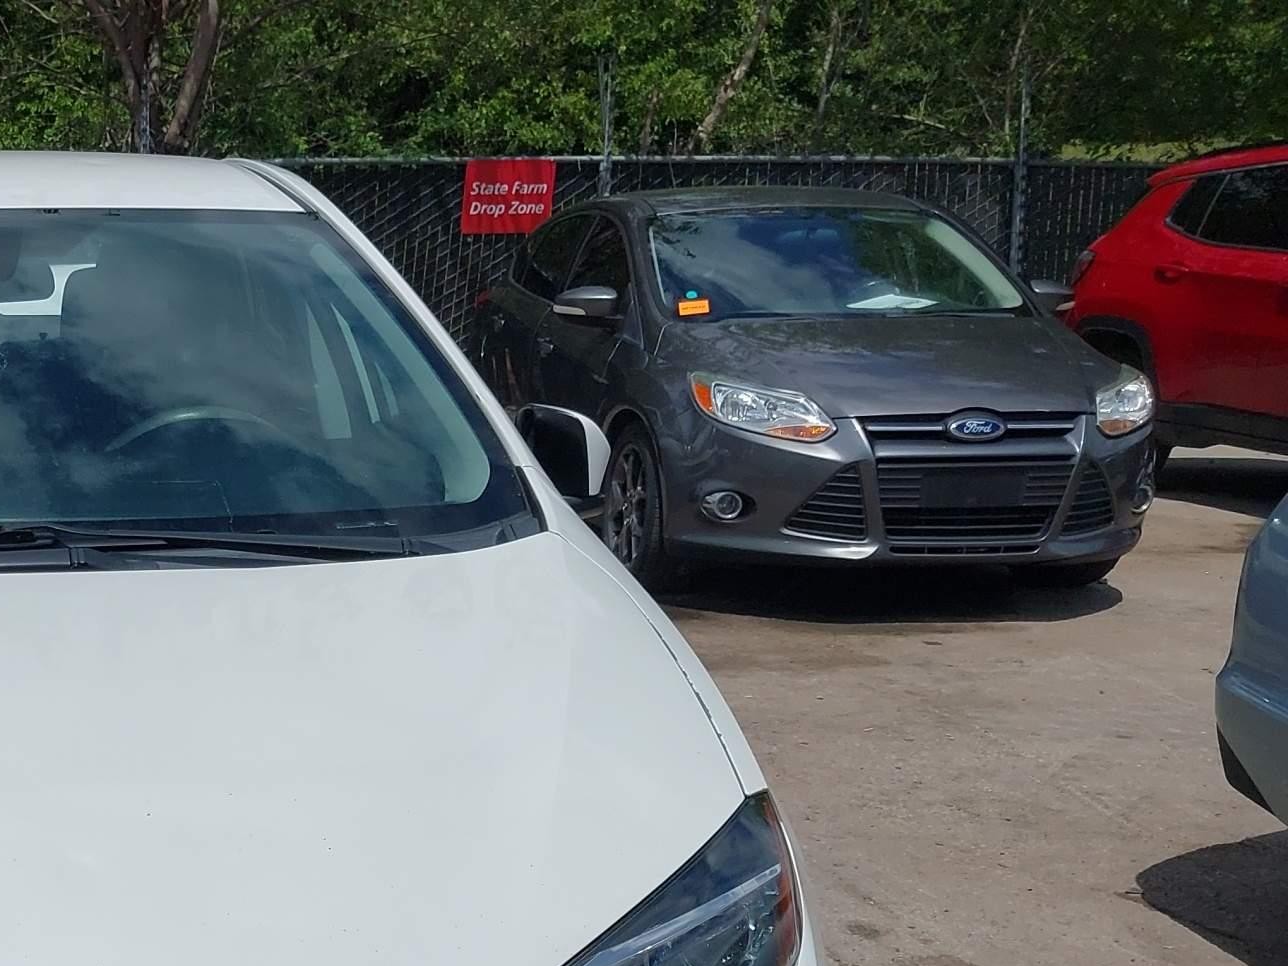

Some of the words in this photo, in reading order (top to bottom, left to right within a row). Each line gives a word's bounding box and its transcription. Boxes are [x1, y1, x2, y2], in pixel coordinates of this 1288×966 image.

[470, 182, 509, 195] State
[511, 181, 548, 194] Farm
[469, 202, 505, 218] Drop
[508, 201, 544, 214] Zone
[963, 420, 993, 434] Ford
